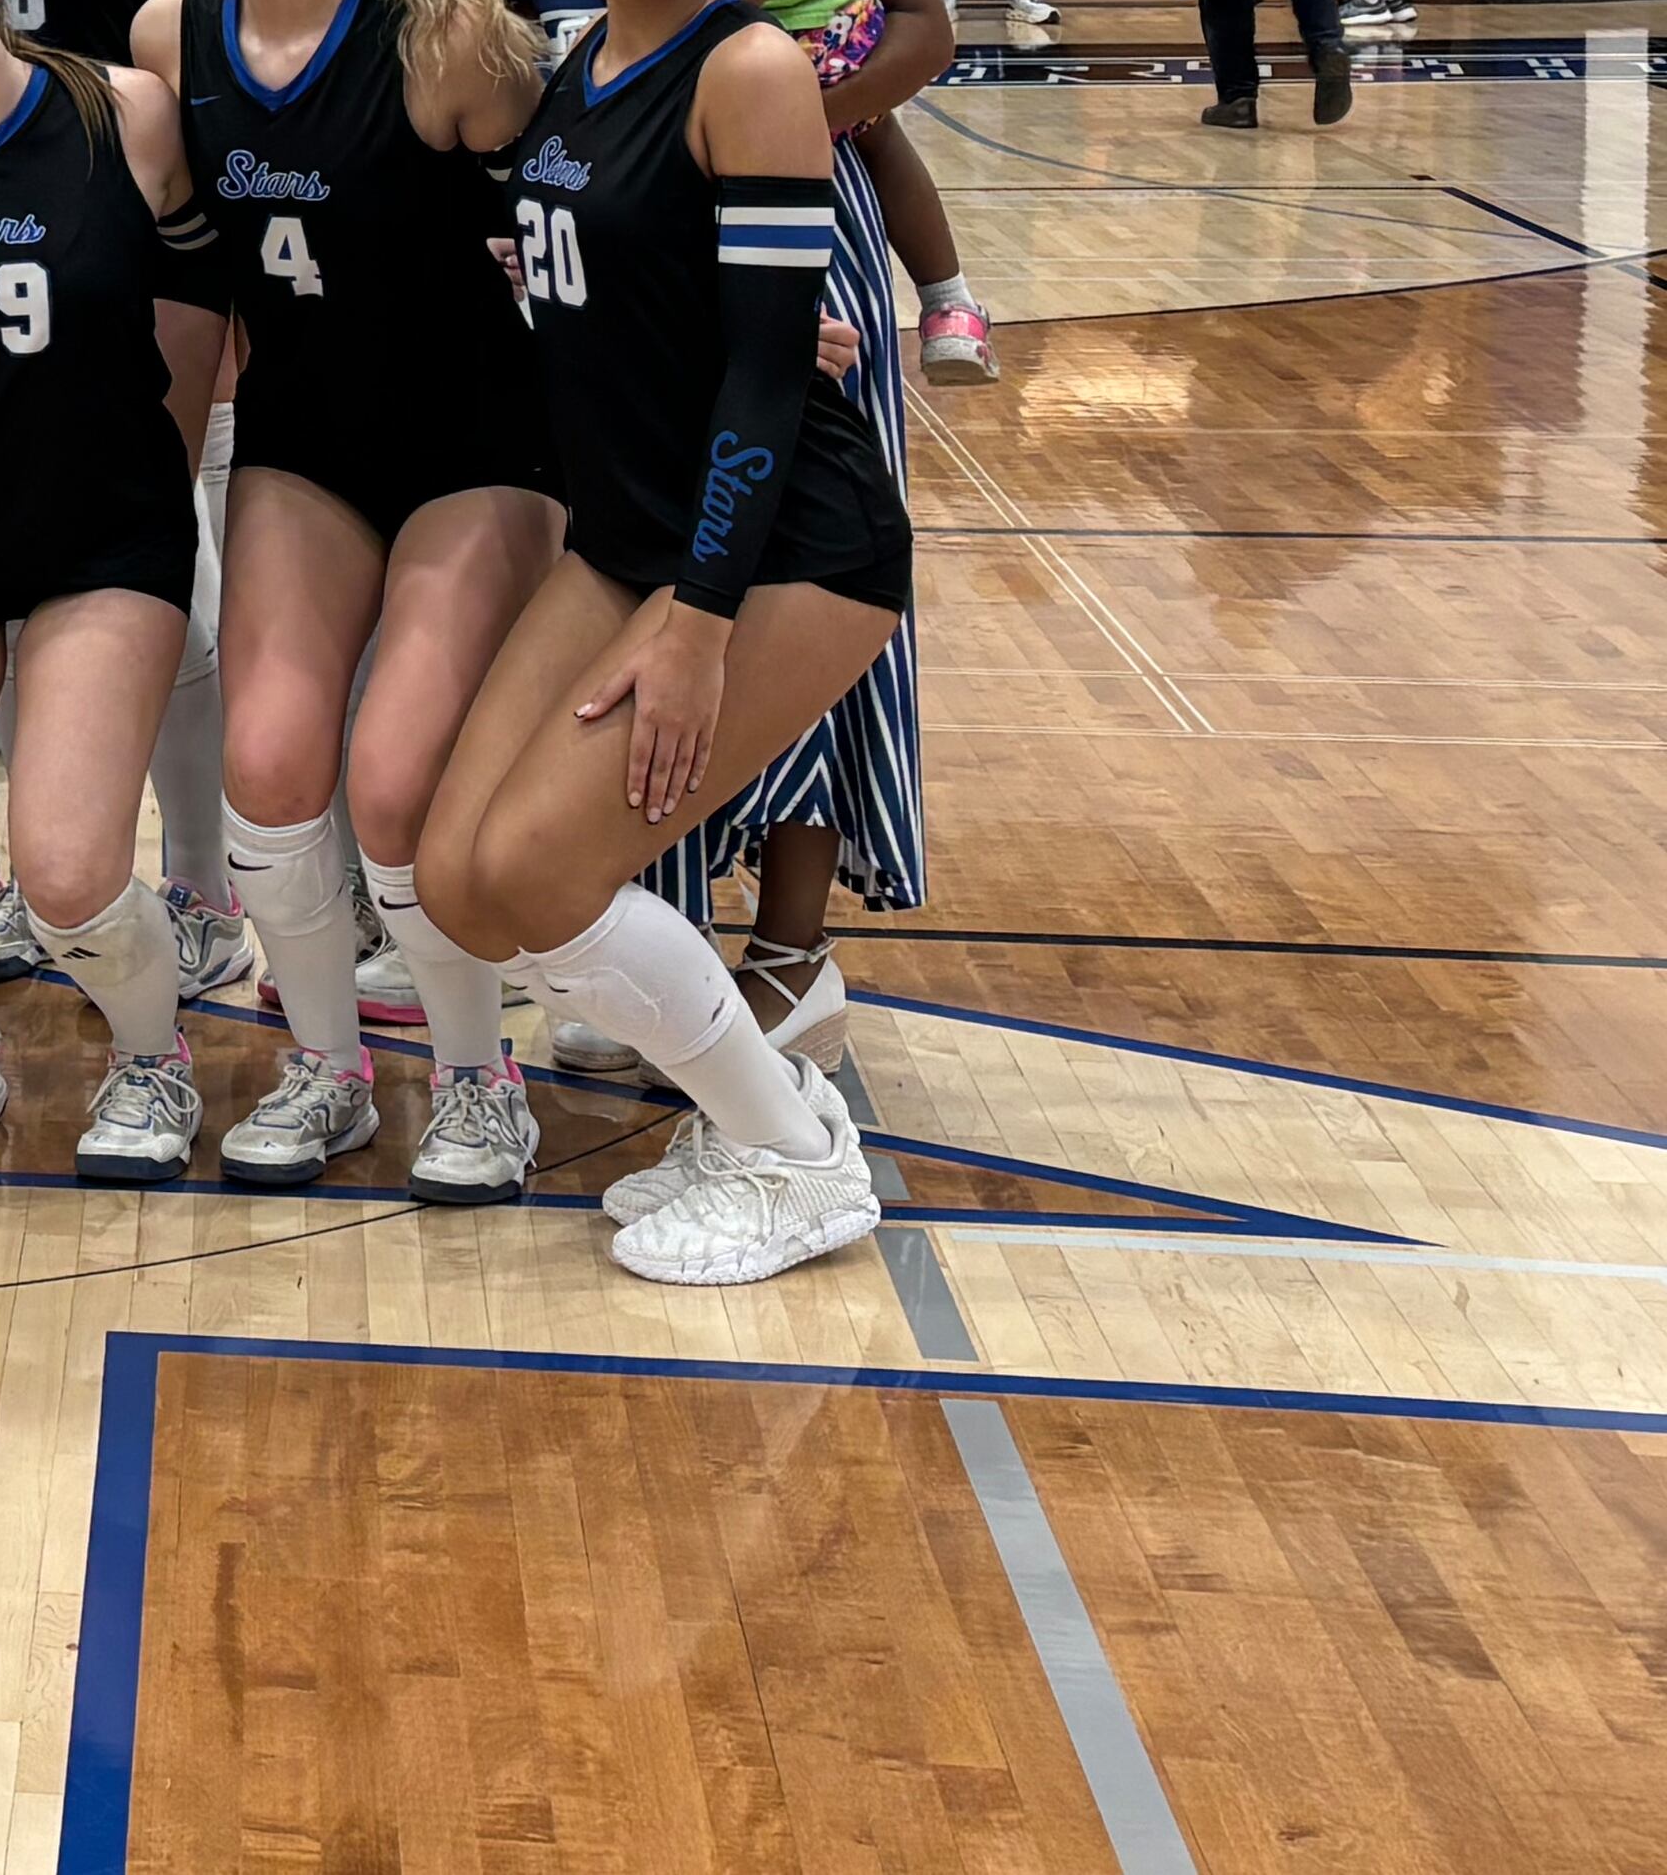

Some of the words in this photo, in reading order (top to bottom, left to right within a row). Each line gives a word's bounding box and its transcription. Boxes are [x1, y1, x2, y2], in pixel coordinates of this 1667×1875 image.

[217, 149, 330, 201] Stars
[522, 135, 593, 192] Stars
[259, 214, 324, 297] 4
[515, 196, 588, 309] 20
[691, 429, 775, 564] Stars
